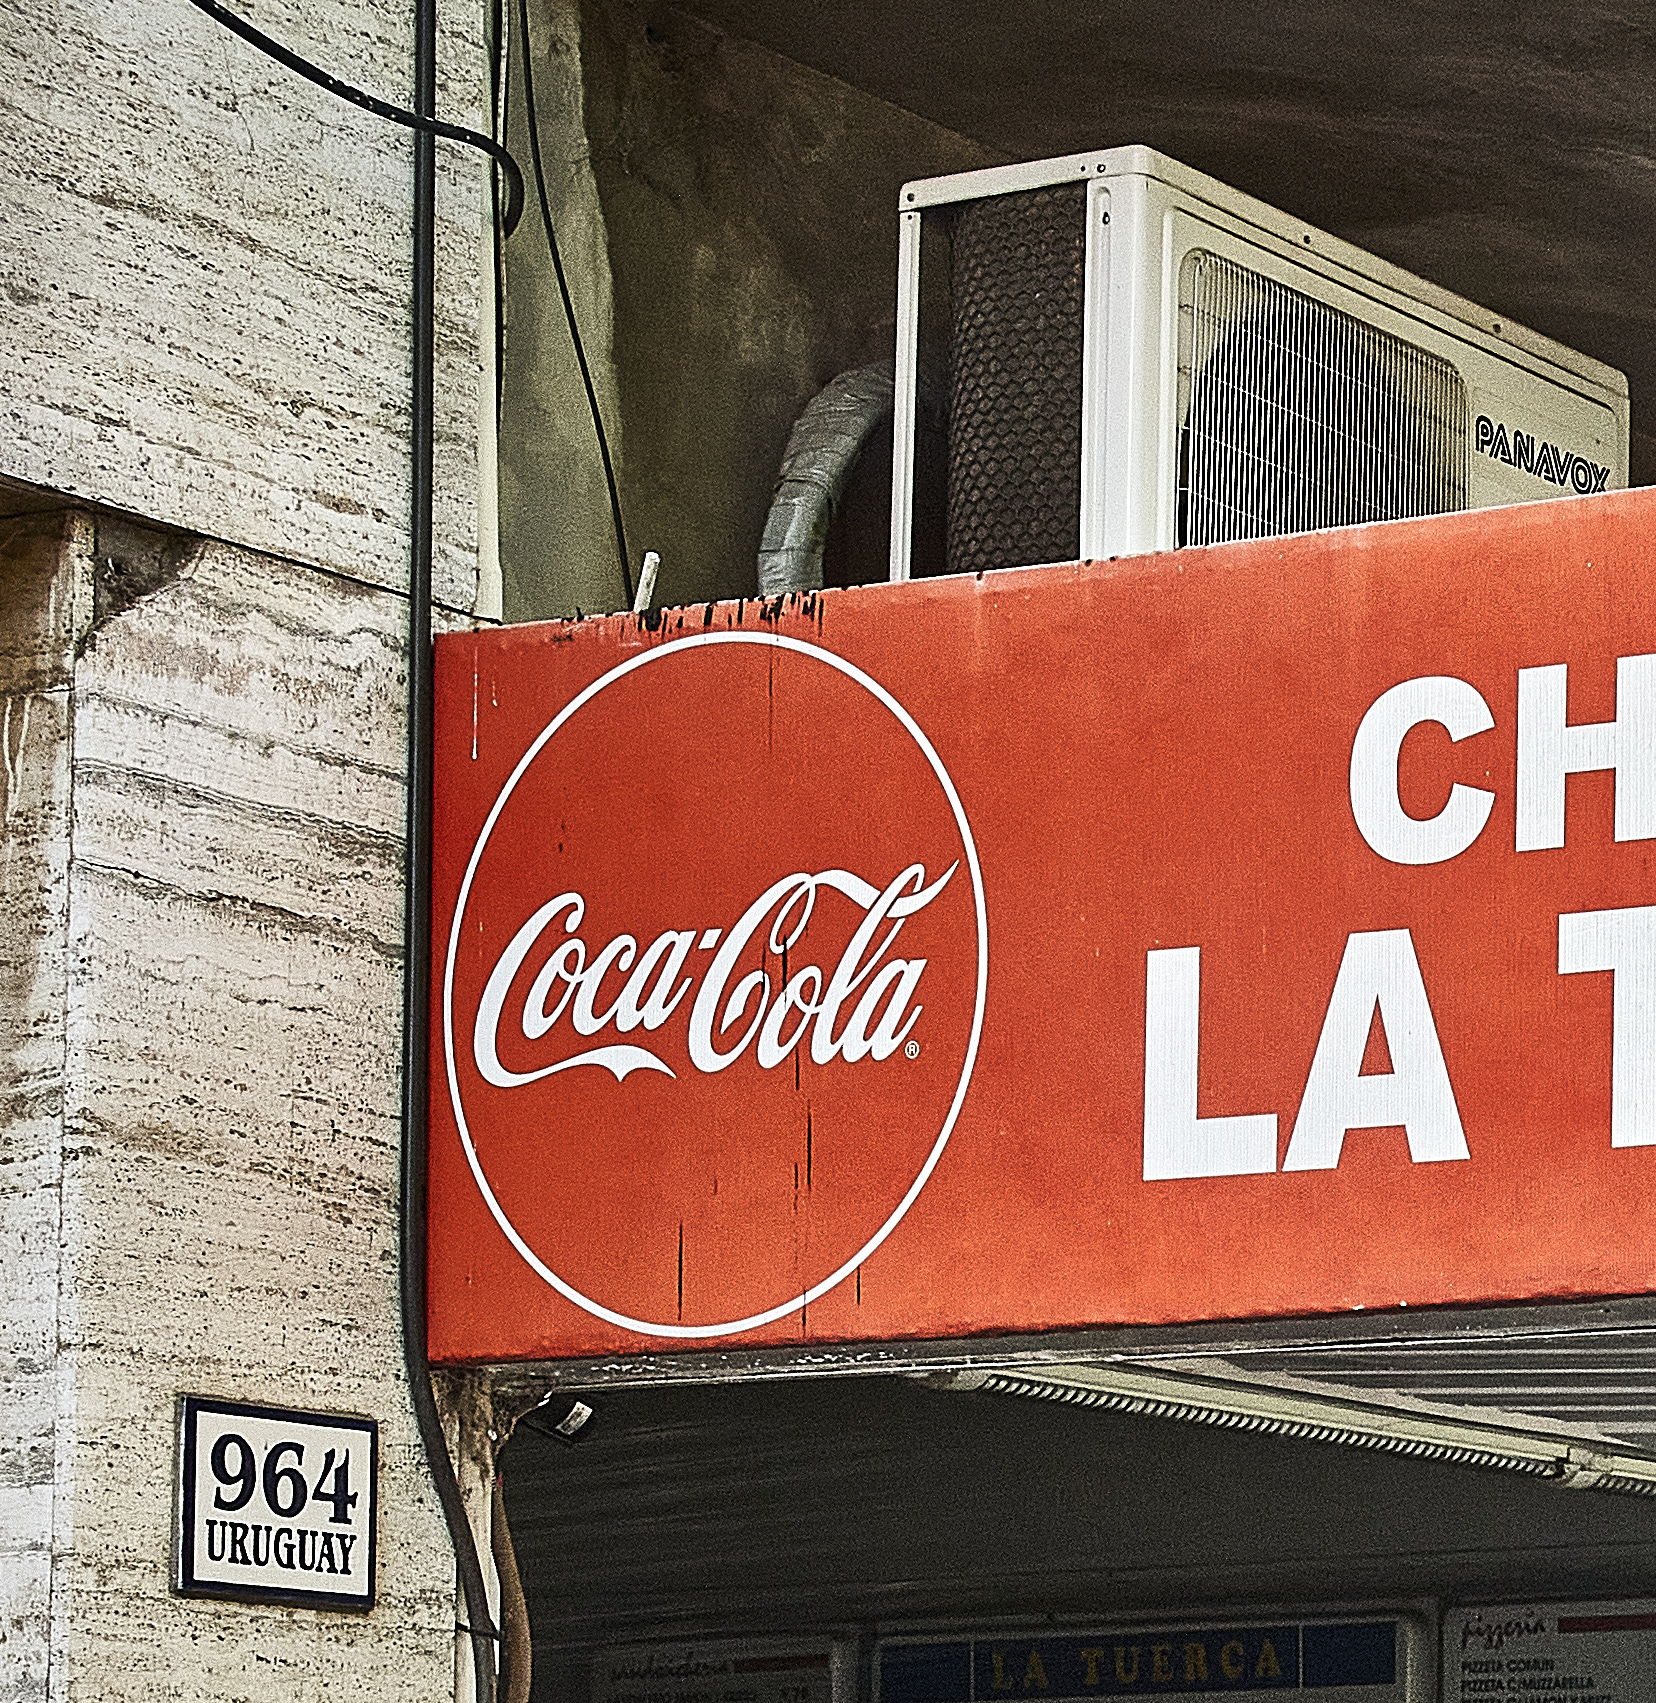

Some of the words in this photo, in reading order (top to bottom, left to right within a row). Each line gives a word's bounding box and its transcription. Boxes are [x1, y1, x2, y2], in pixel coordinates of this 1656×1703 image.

[1475, 414, 1611, 495] PANAVOX
[474, 859, 959, 1088] Coca-Cola
[1142, 928, 1472, 1183] LA
[210, 1433, 359, 1525] 964
[204, 1517, 356, 1577] URUGUAY
[991, 1649, 1050, 1691] LA
[1080, 1638, 1282, 1686] TUERCA
